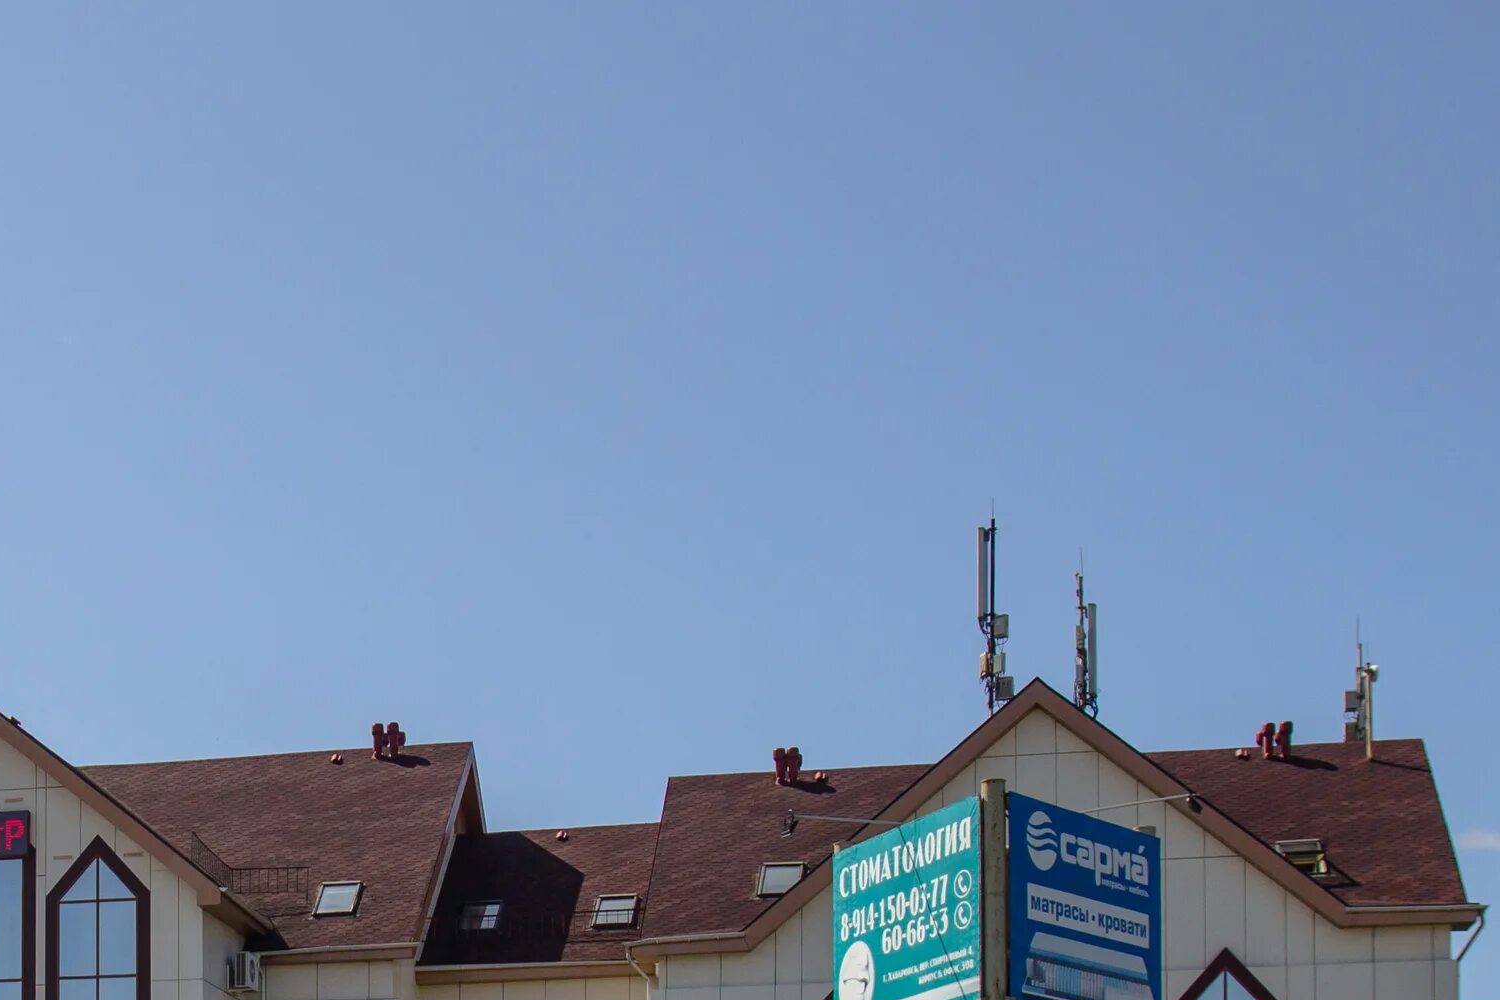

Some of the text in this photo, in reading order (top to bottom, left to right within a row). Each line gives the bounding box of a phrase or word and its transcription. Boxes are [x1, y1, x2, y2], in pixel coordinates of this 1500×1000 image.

[840, 816, 972, 898] СТОМАТОЛОГИЯ
[841, 874, 949, 942] 8-914-150-03-77
[882, 907, 949, 954] 60-66-53
[1030, 895, 1148, 939] матрасы кровати
